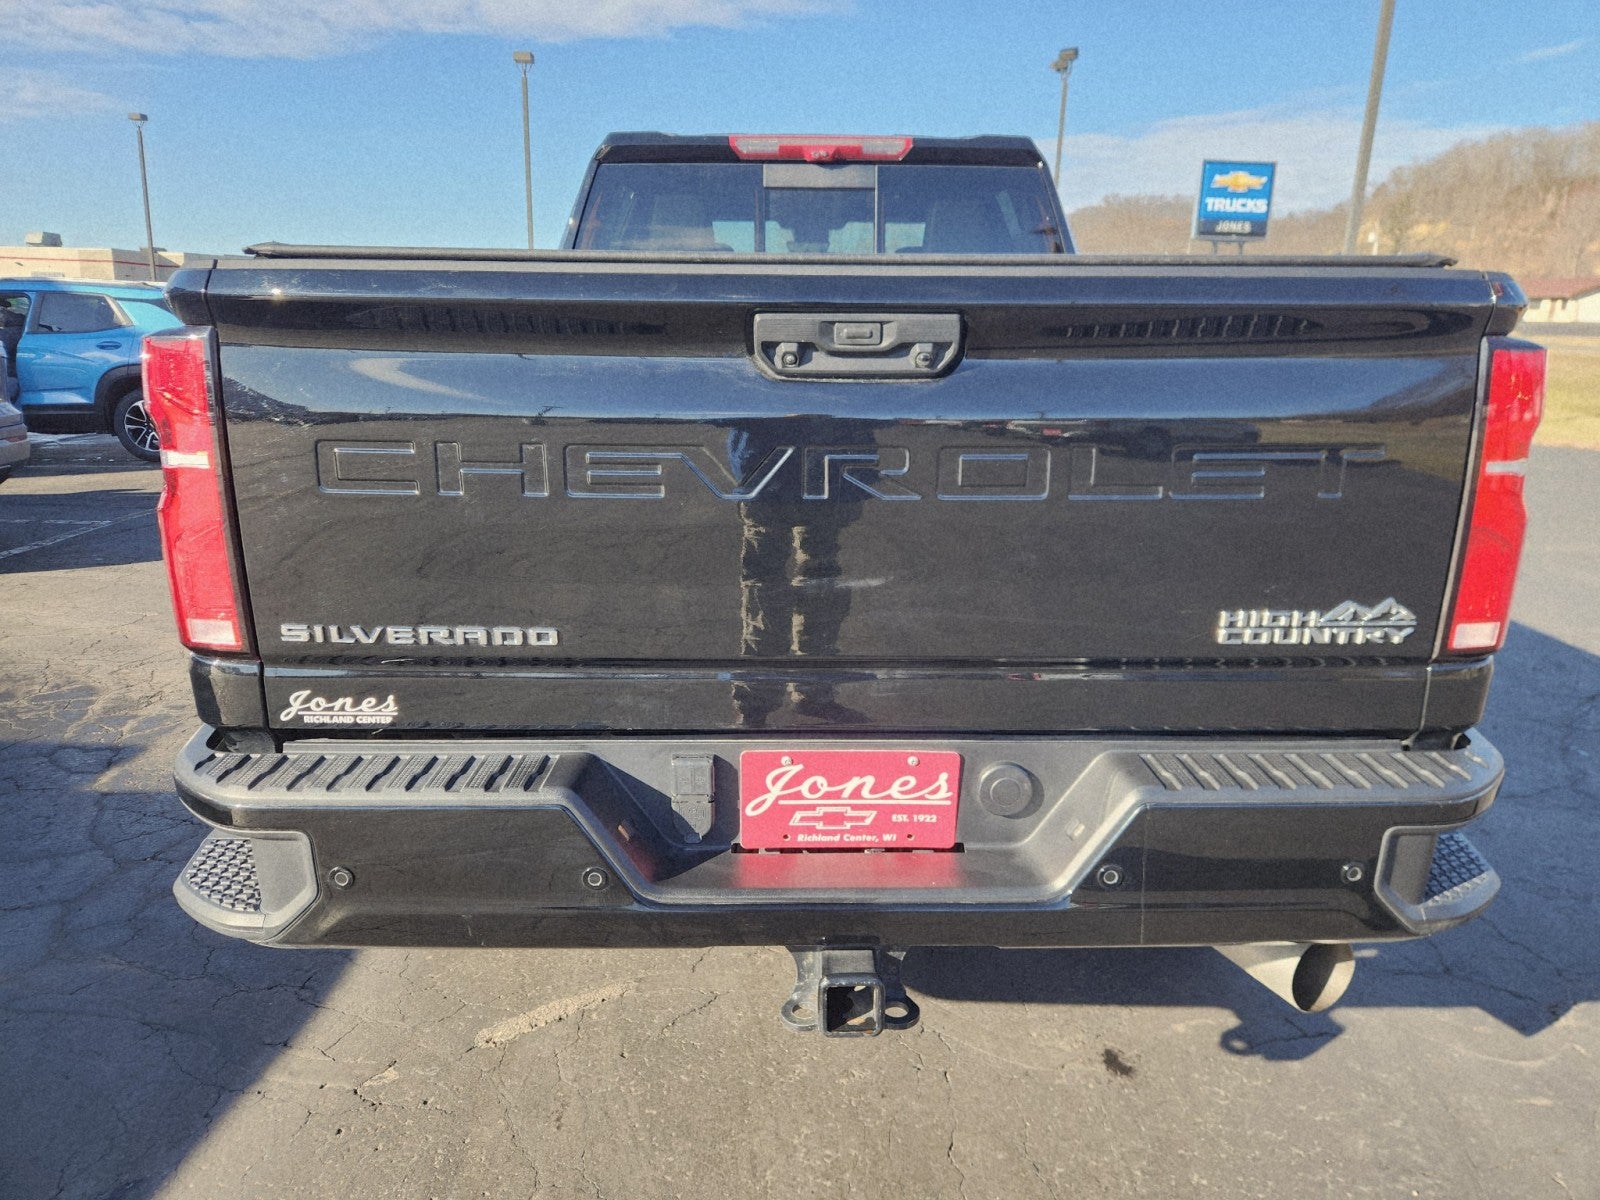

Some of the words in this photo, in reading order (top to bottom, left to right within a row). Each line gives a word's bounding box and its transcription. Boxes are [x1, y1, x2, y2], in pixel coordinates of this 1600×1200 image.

[1205, 197, 1268, 213] TRUCKS
[315, 440, 1387, 501] CHEVROLET
[1218, 609, 1322, 628] HIGH
[280, 623, 559, 646] SILVERADO
[1216, 627, 1415, 645] COUNTRY
[280, 690, 398, 722] Jones
[303, 715, 354, 724] RICHLAND
[745, 763, 953, 817] Jones
[891, 814, 910, 823] EST.
[913, 814, 937, 823] 1922
[797, 832, 840, 843] Richland
[843, 833, 880, 843] Center,
[882, 833, 897, 842] WI
